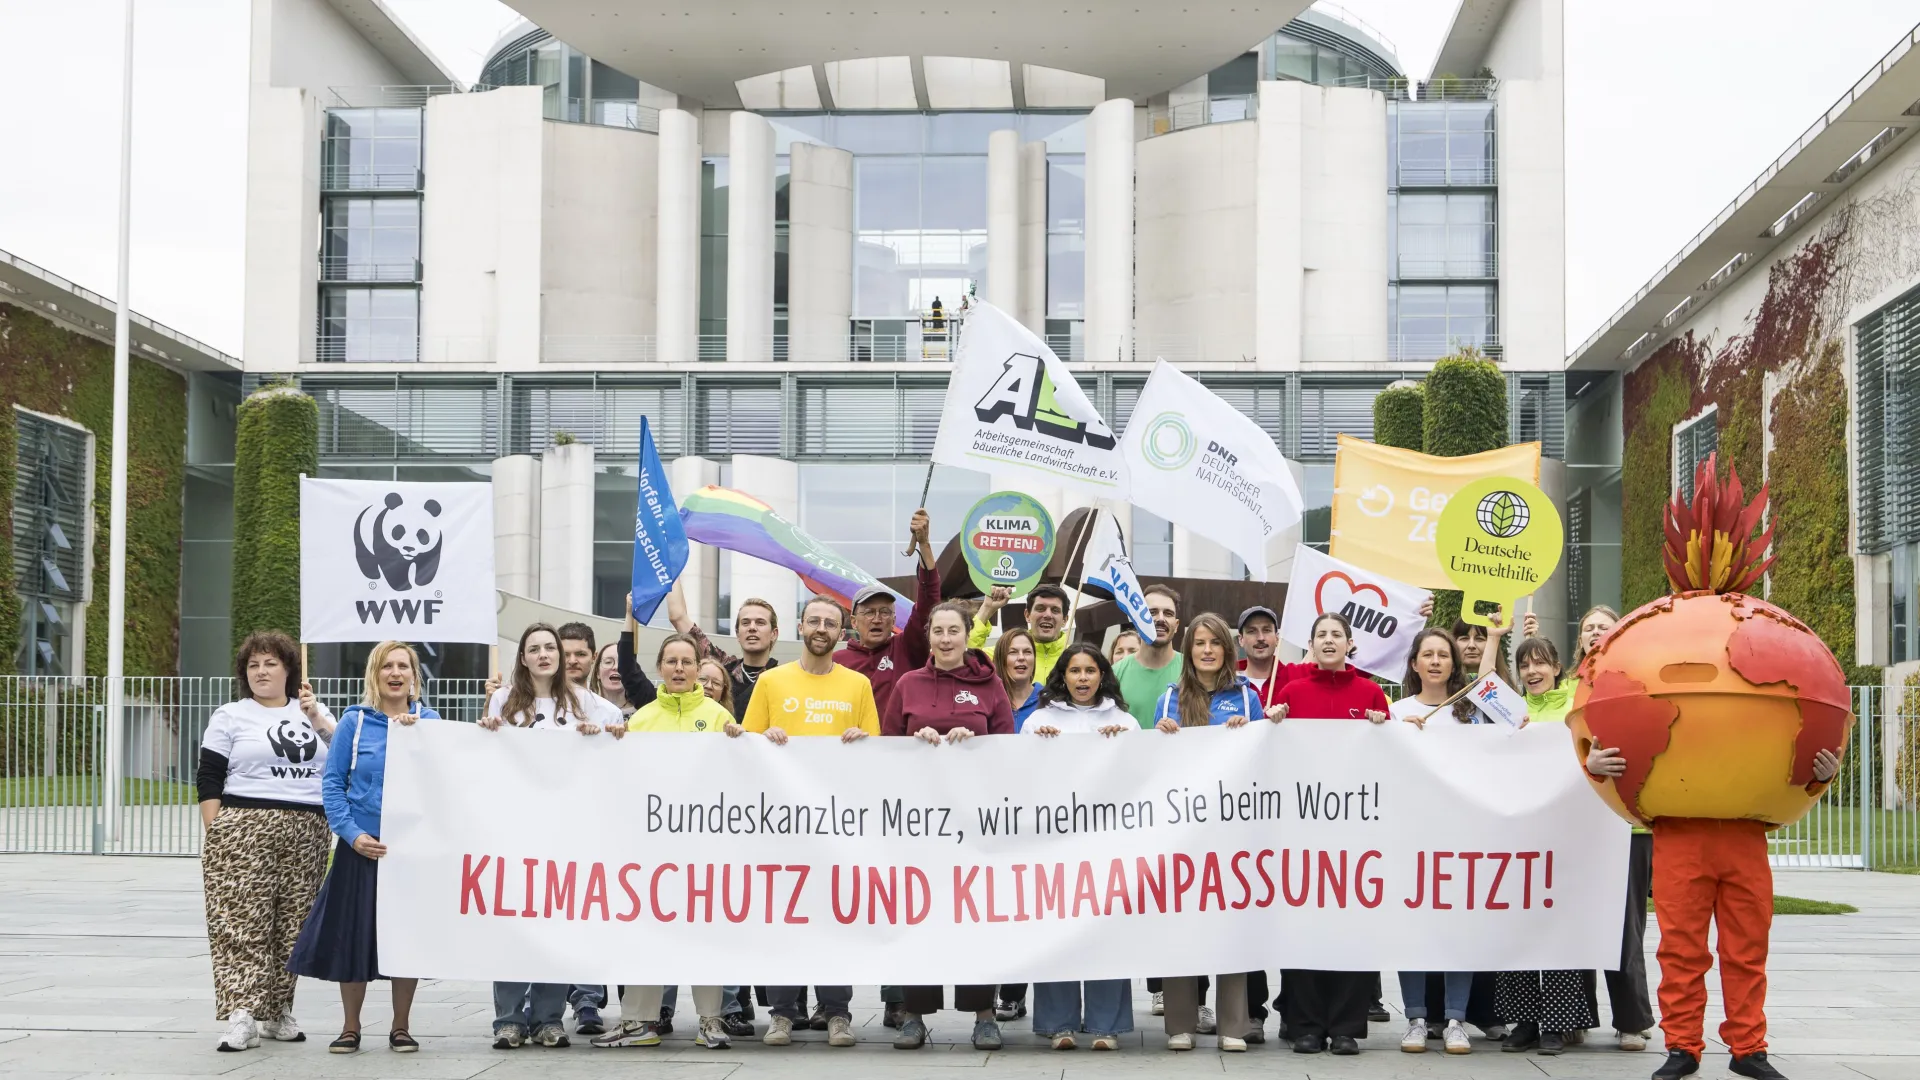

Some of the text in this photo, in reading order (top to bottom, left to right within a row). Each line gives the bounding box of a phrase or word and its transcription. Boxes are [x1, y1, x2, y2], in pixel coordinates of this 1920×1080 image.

[974, 428, 1075, 459] Arbeitsgemeinschaft
[1207, 440, 1239, 467] DNR
[972, 441, 1118, 480] bäuerliche Landwirtschaft e.V.
[1201, 453, 1261, 498] DEUTSCHER
[986, 519, 1031, 531] KLIMA
[980, 535, 1037, 550] RETTEN!
[1464, 536, 1532, 561] Deutsche
[994, 569, 1017, 577] BUND
[1450, 555, 1539, 583] Umwelthilfe
[355, 599, 443, 625] WWF
[1339, 601, 1398, 639] AWO
[804, 710, 833, 723] Zero
[805, 697, 852, 713] German
[270, 766, 317, 779] WWF
[647, 779, 1380, 844] Bundeskanzler Merz, wir nehmen Sie beim Wort!
[459, 848, 1554, 925] KLIMASCHUTZ UND KLIMAANPASSUNG JETZT!
